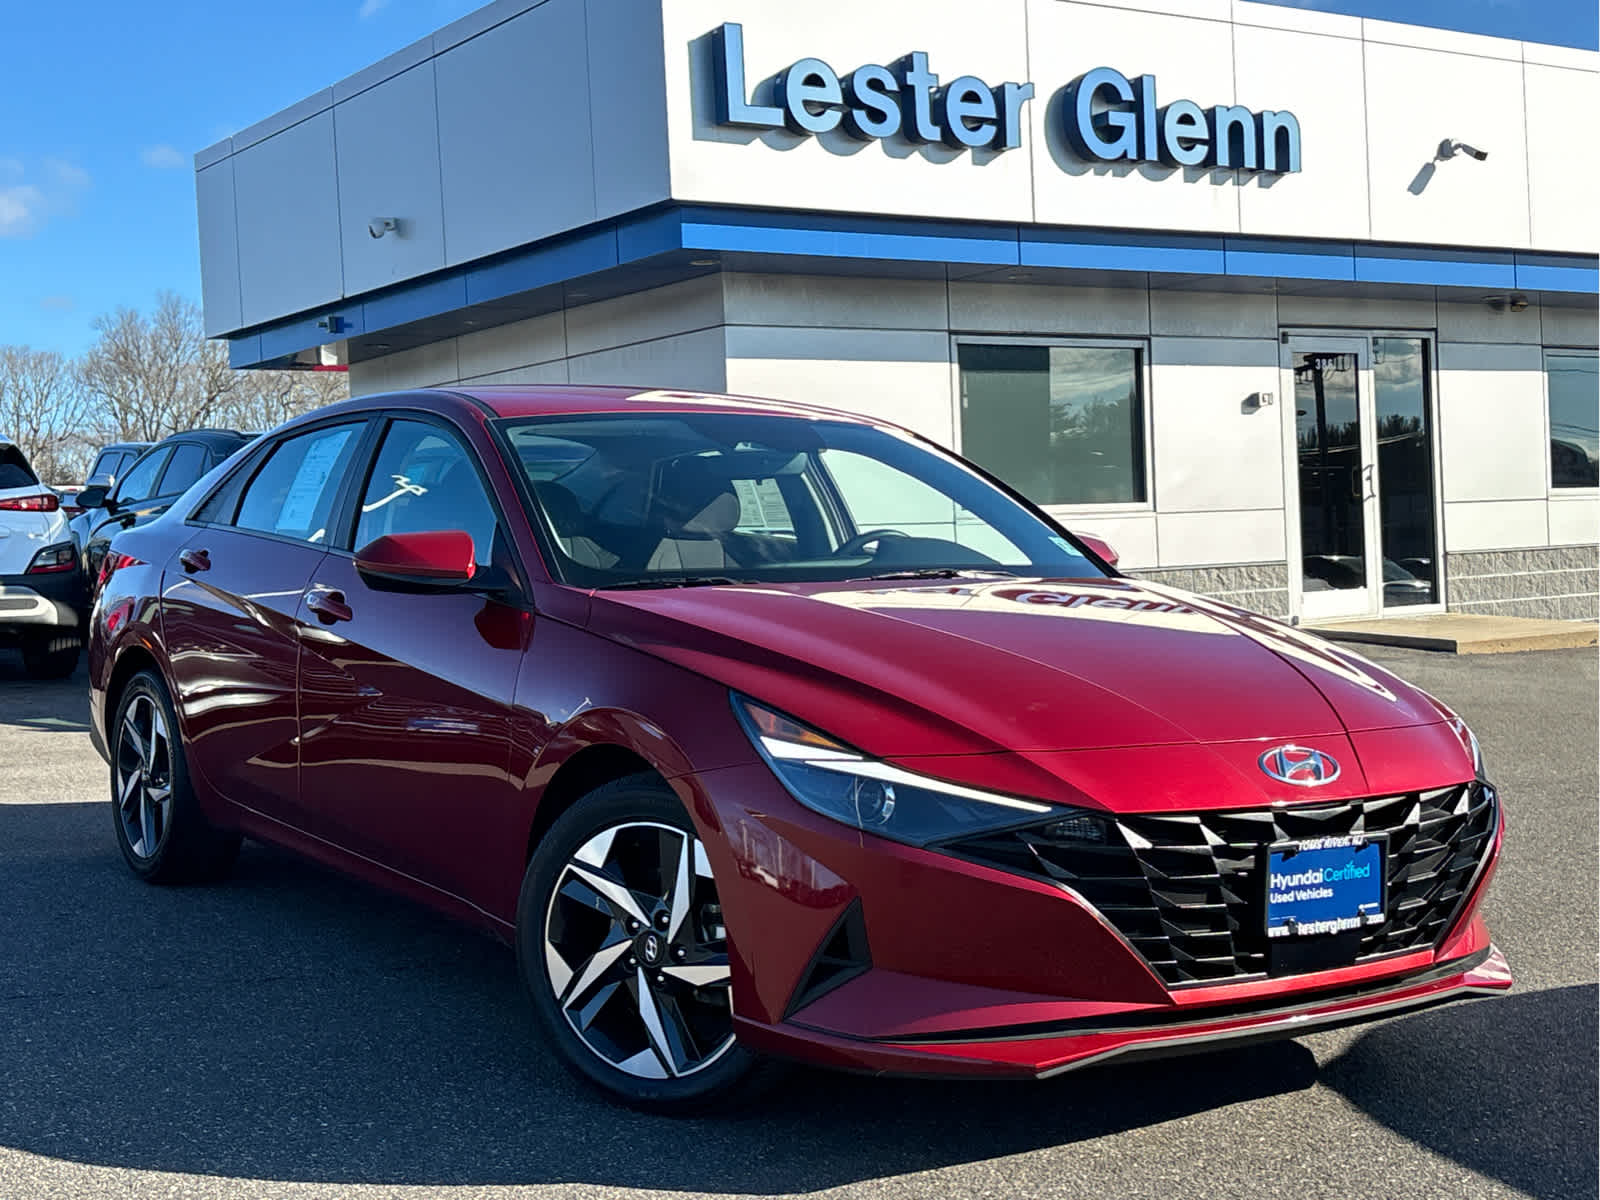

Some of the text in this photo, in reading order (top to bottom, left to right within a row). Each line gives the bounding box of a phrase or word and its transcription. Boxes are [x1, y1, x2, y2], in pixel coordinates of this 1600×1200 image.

[718, 22, 1301, 173] Lester Glenn
[1270, 861, 1370, 890] Hyundai Certified
[1270, 888, 1333, 904] Used Vehicles
